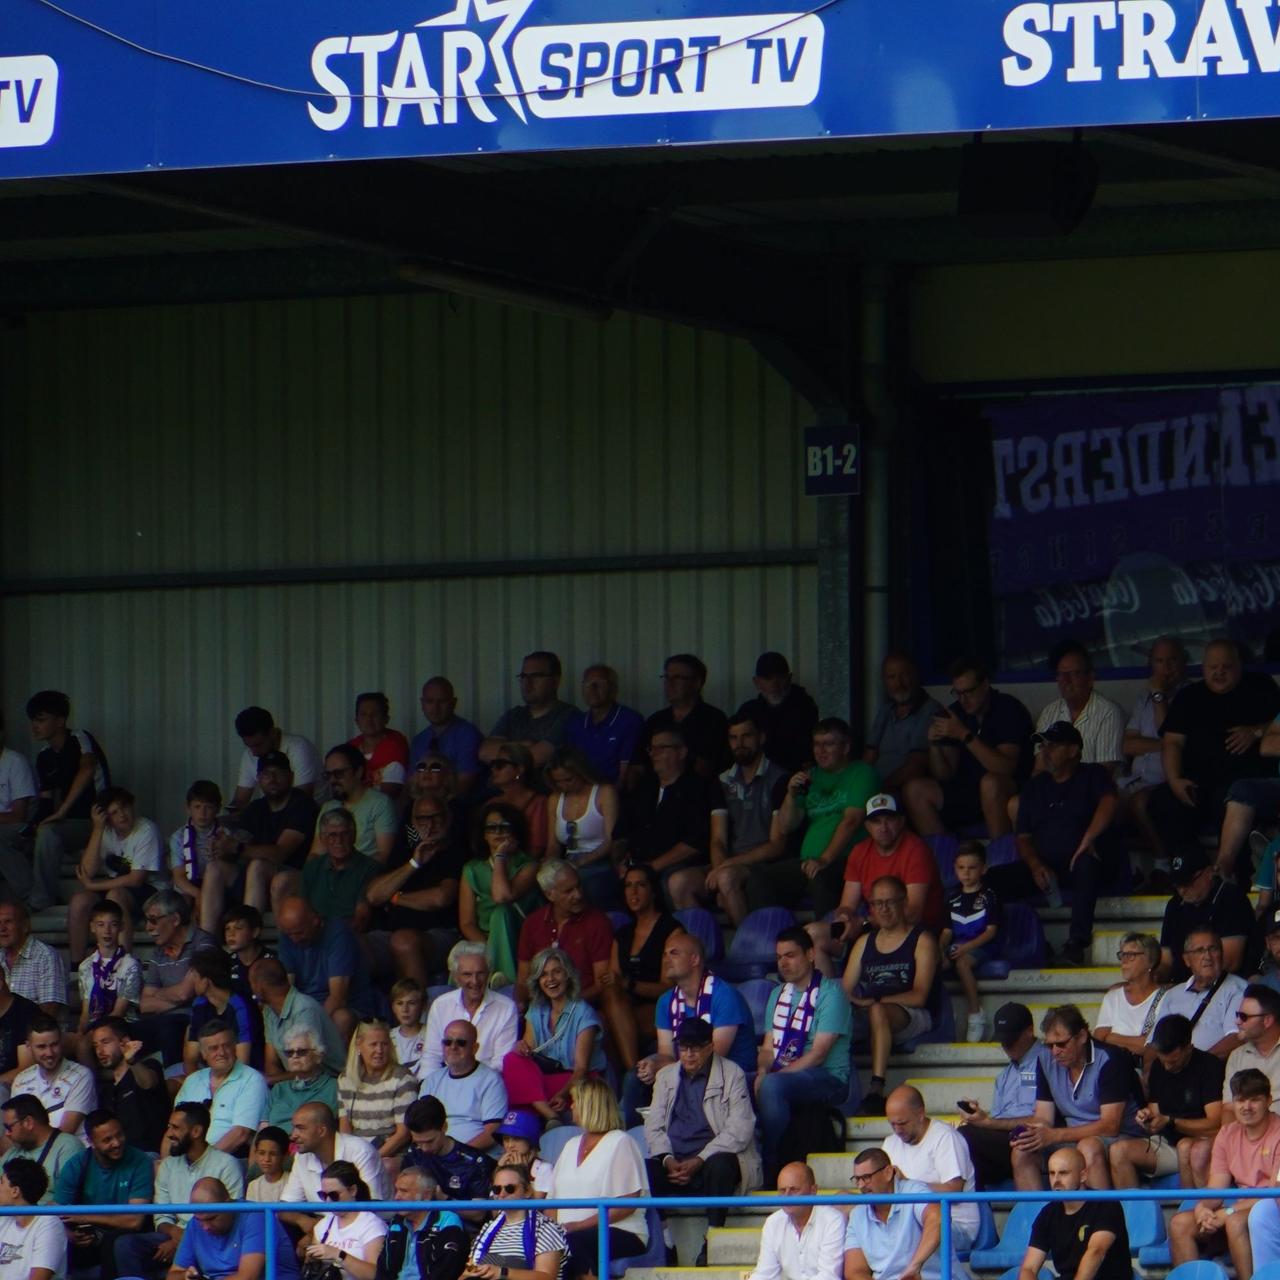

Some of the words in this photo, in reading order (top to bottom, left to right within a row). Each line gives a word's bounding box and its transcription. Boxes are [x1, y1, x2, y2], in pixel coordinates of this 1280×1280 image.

[307, 30, 498, 131] STAR
[538, 35, 721, 102] SPORT
[746, 36, 808, 85] TV
[807, 444, 857, 478] B1-2
